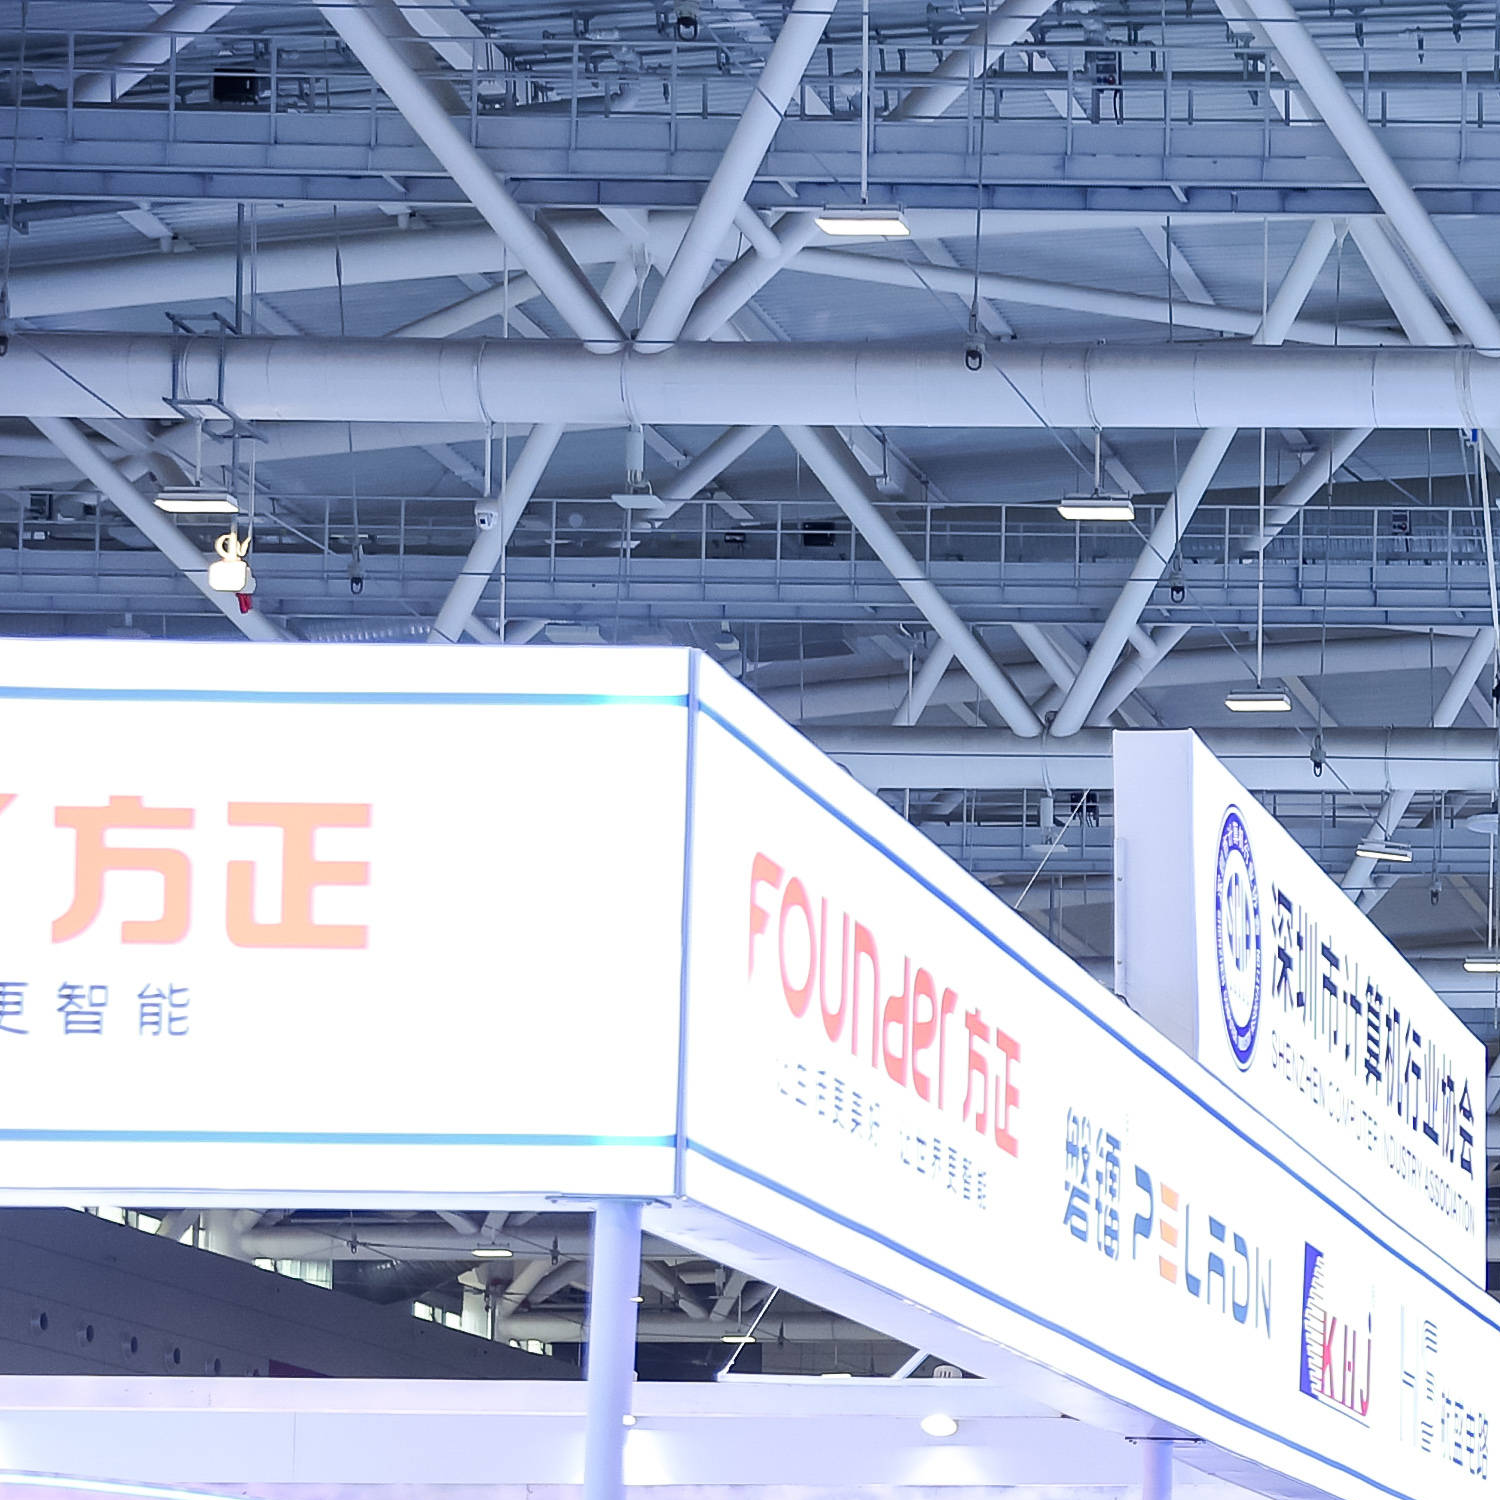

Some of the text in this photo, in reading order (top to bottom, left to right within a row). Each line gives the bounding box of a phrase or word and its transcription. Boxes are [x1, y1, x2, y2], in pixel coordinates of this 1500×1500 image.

[50, 795, 374, 950] 方正
[963, 1006, 1022, 1158] 方正
[1272, 882, 1475, 1181] 深圳市计算机行业协会
